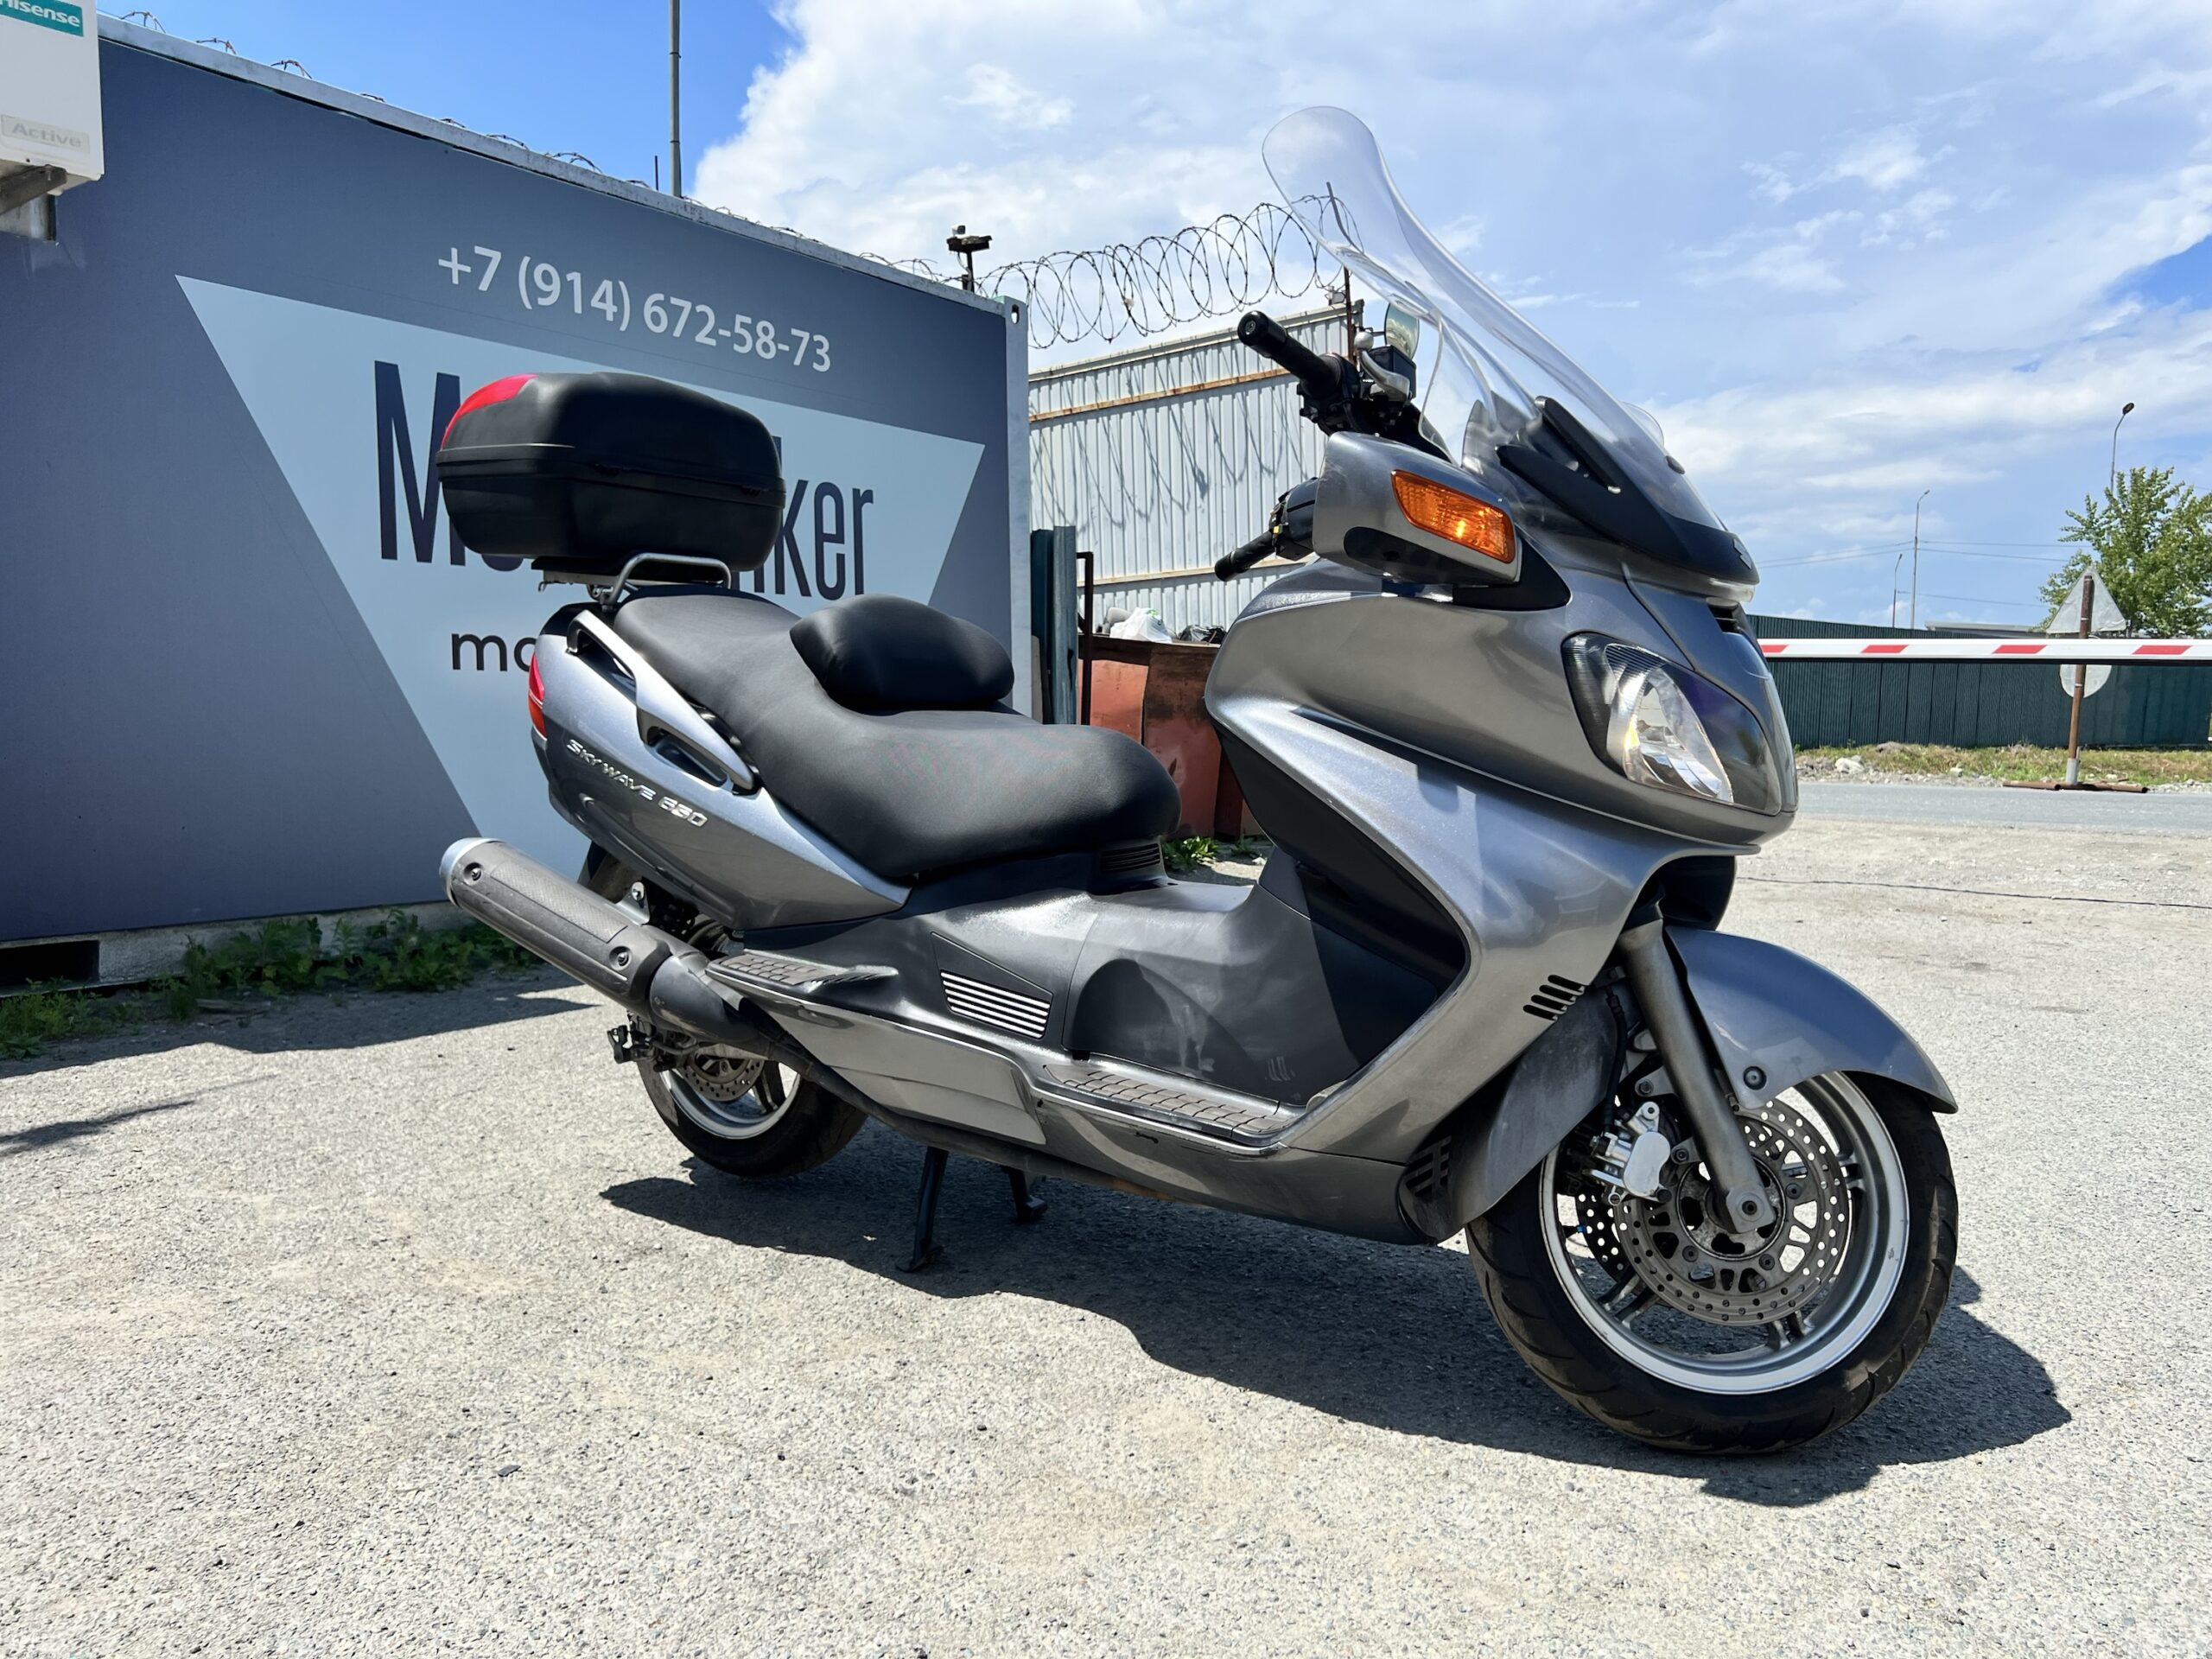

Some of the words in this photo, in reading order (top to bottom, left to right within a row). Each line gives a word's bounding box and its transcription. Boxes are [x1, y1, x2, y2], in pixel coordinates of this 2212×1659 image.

[12, 123, 81, 148] Active
[438, 245, 501, 291] +7
[518, 256, 631, 332] (914)
[643, 293, 831, 372] 672-58-73
[566, 739, 657, 801] SKYWAVE
[658, 796, 708, 827] 650
